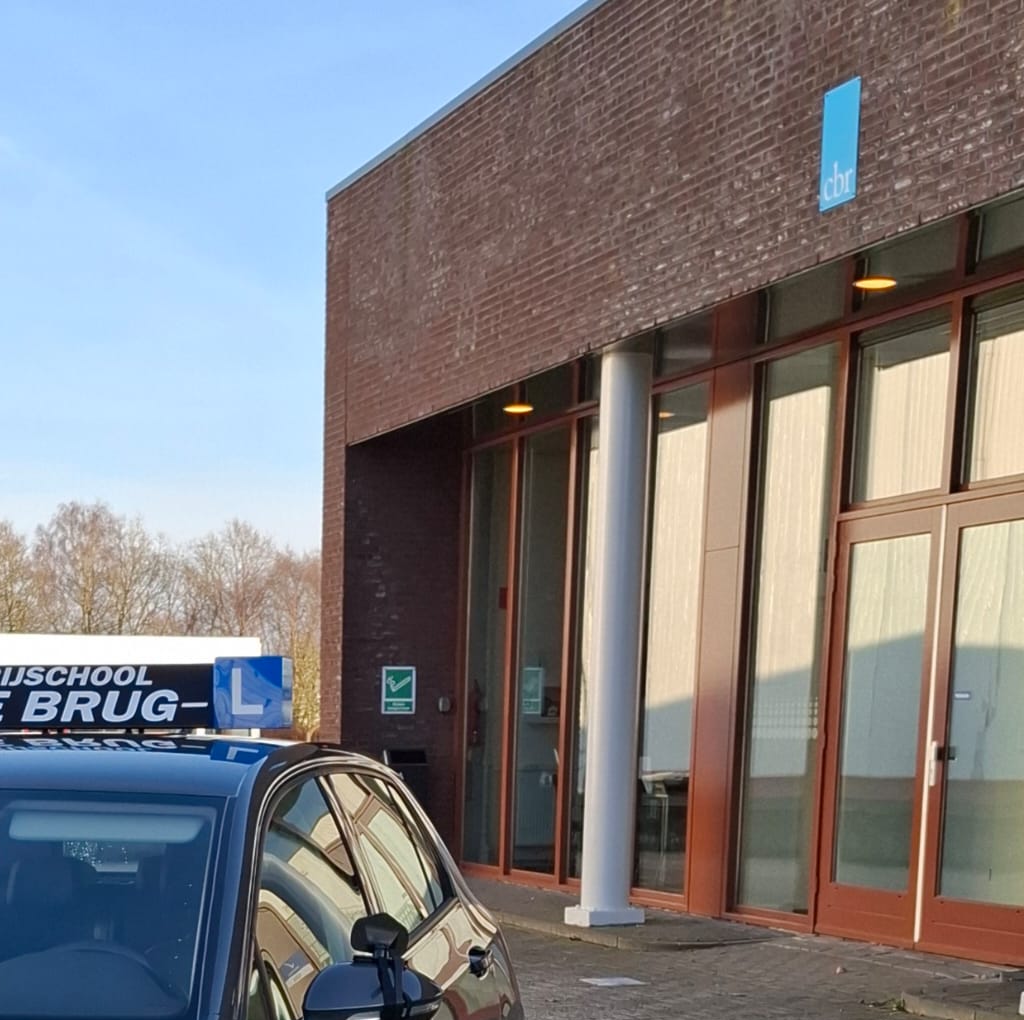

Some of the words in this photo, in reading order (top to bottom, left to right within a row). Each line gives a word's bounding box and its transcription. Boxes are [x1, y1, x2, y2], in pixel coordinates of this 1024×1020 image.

[823, 161, 854, 201] cbr
[20, 689, 179, 722] BRUG
[231, 667, 264, 715] L
